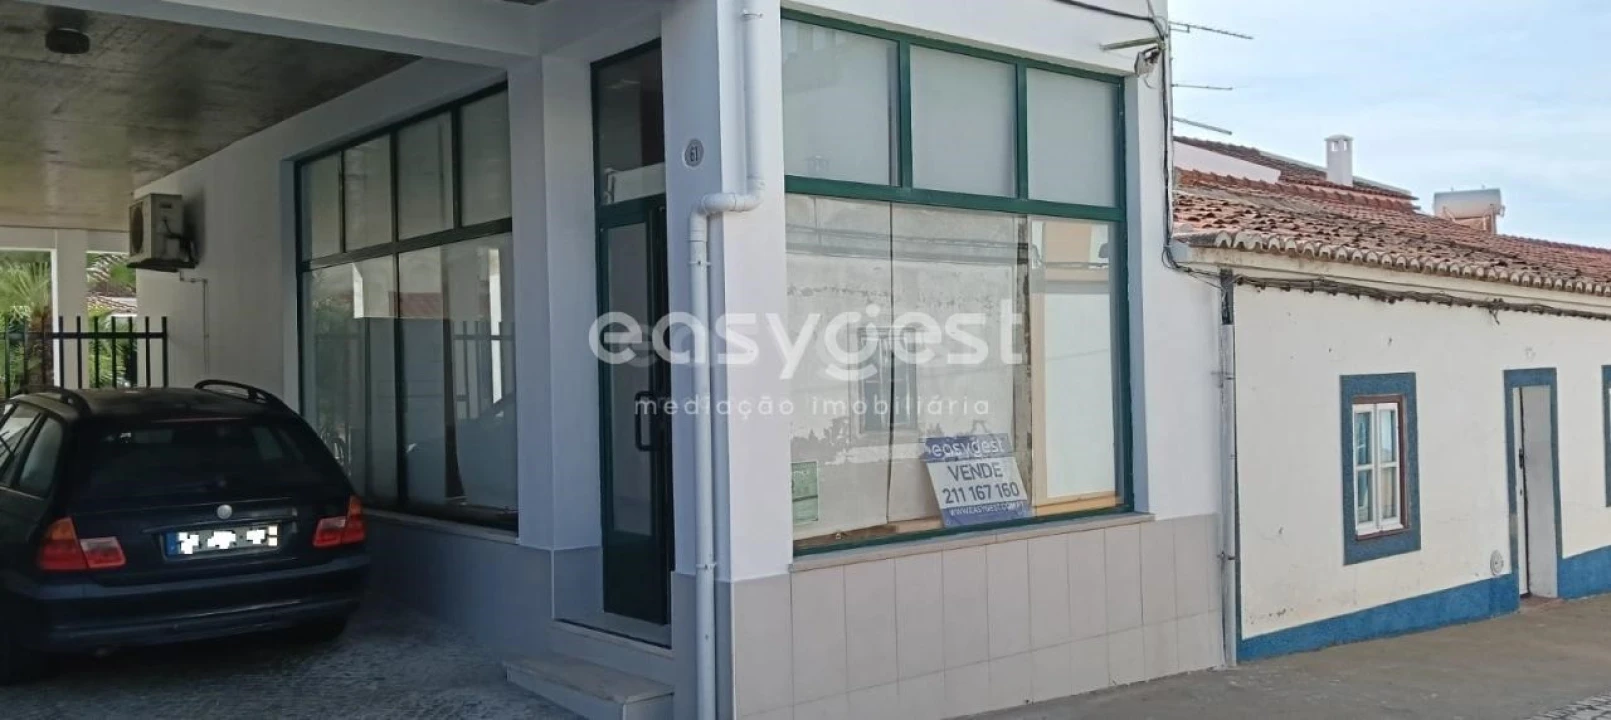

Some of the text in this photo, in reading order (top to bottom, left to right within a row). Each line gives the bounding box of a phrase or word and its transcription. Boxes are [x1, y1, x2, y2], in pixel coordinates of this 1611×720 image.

[689, 145, 698, 162] 61
[931, 440, 1003, 458] easygest
[947, 462, 1003, 482] VENDE
[942, 481, 1020, 505] 211 167 160
